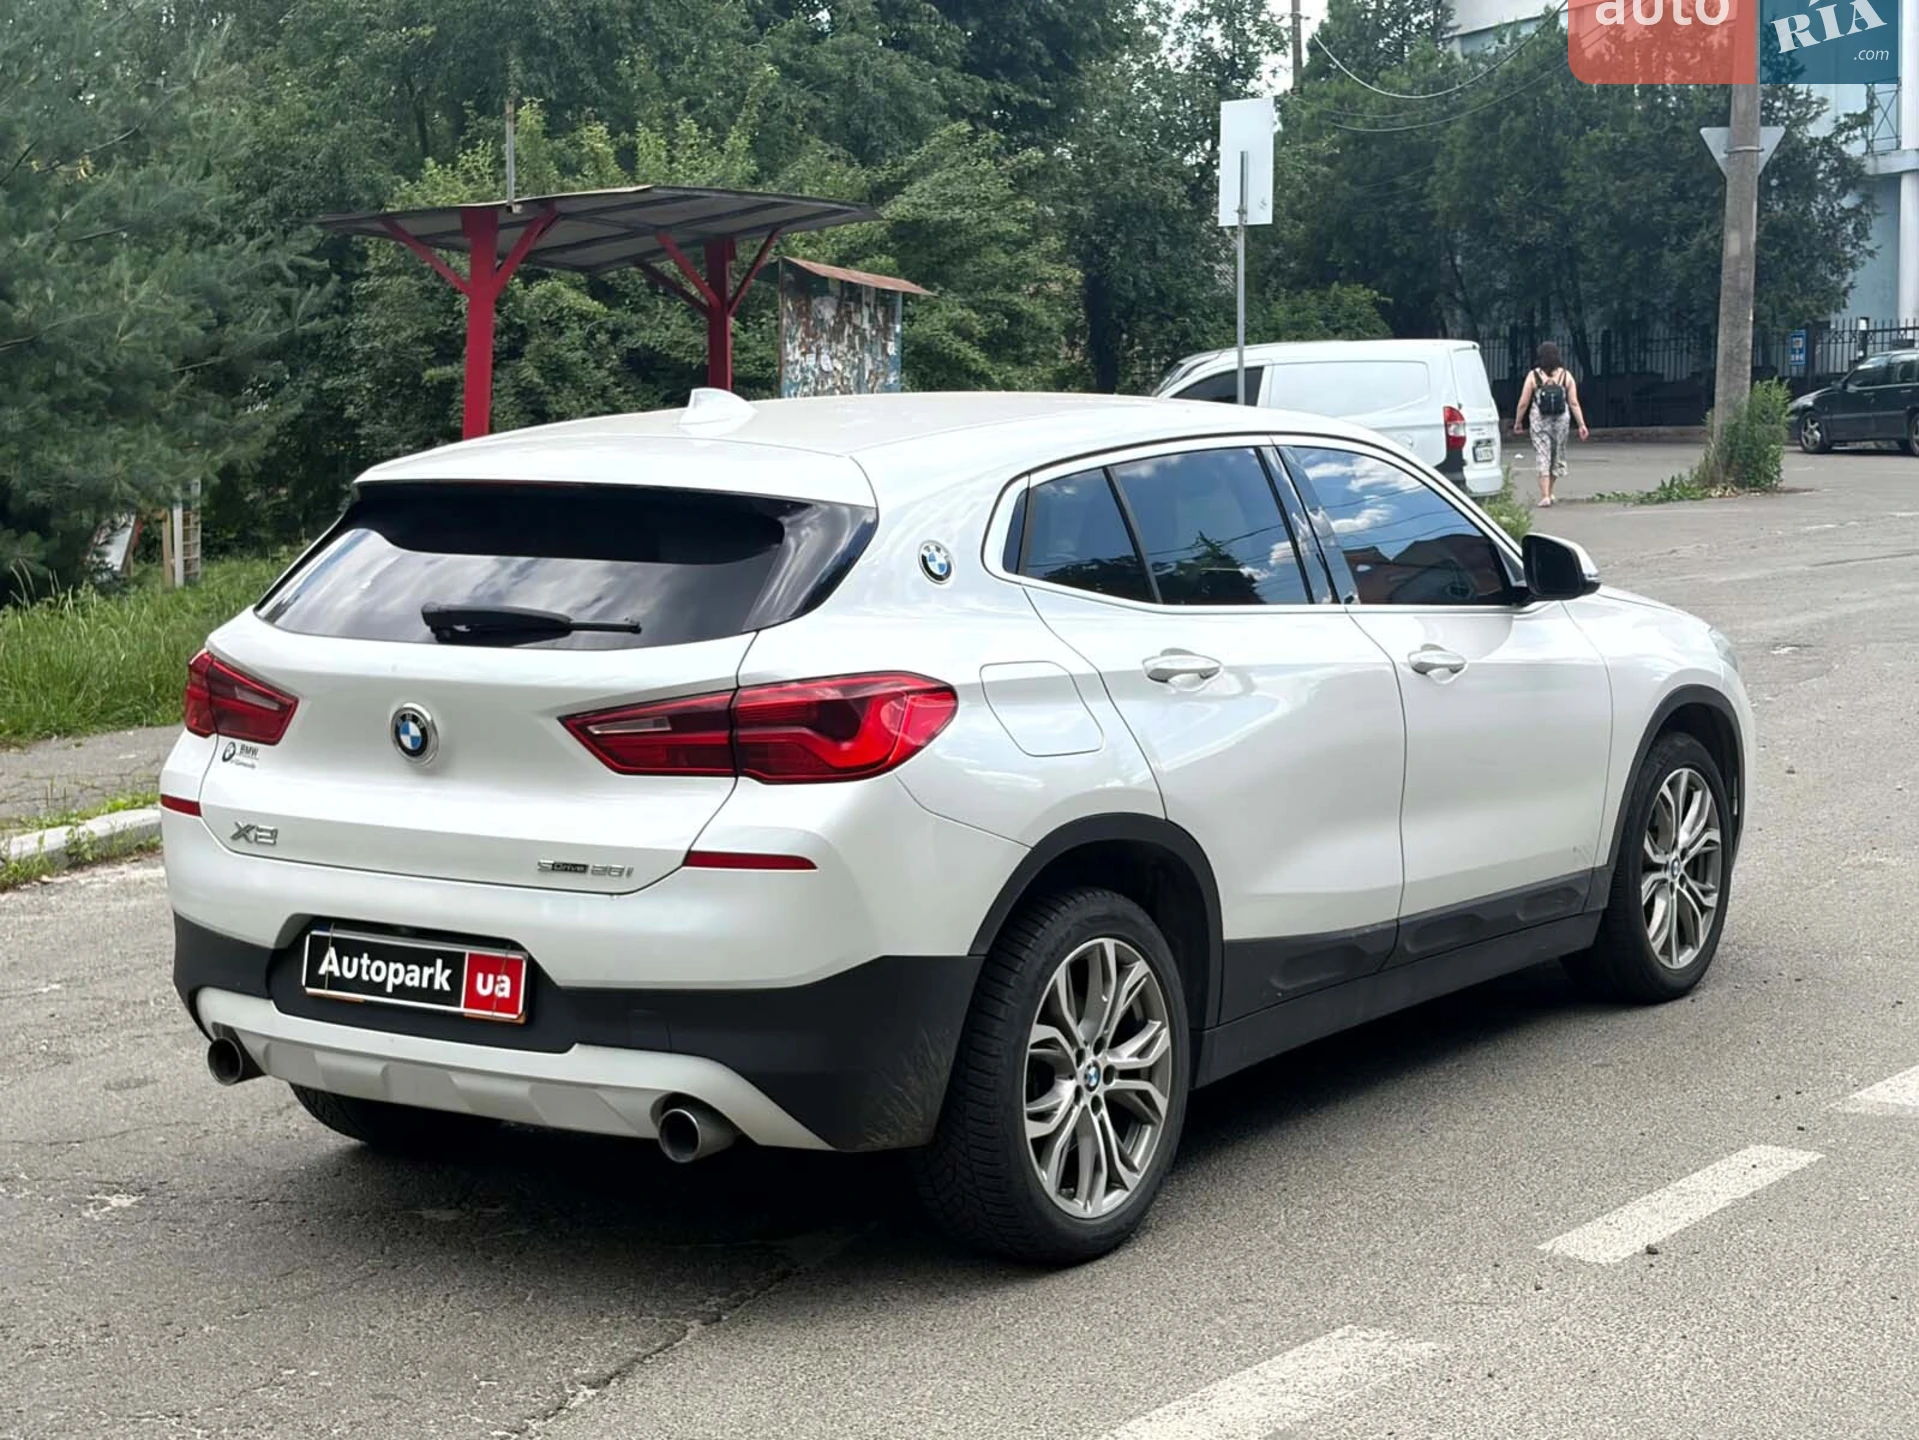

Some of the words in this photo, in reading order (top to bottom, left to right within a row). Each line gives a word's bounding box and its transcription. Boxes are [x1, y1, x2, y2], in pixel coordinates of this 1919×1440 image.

[230, 821, 278, 846] X2
[318, 946, 453, 993] Autopark
[475, 971, 511, 998] ua
